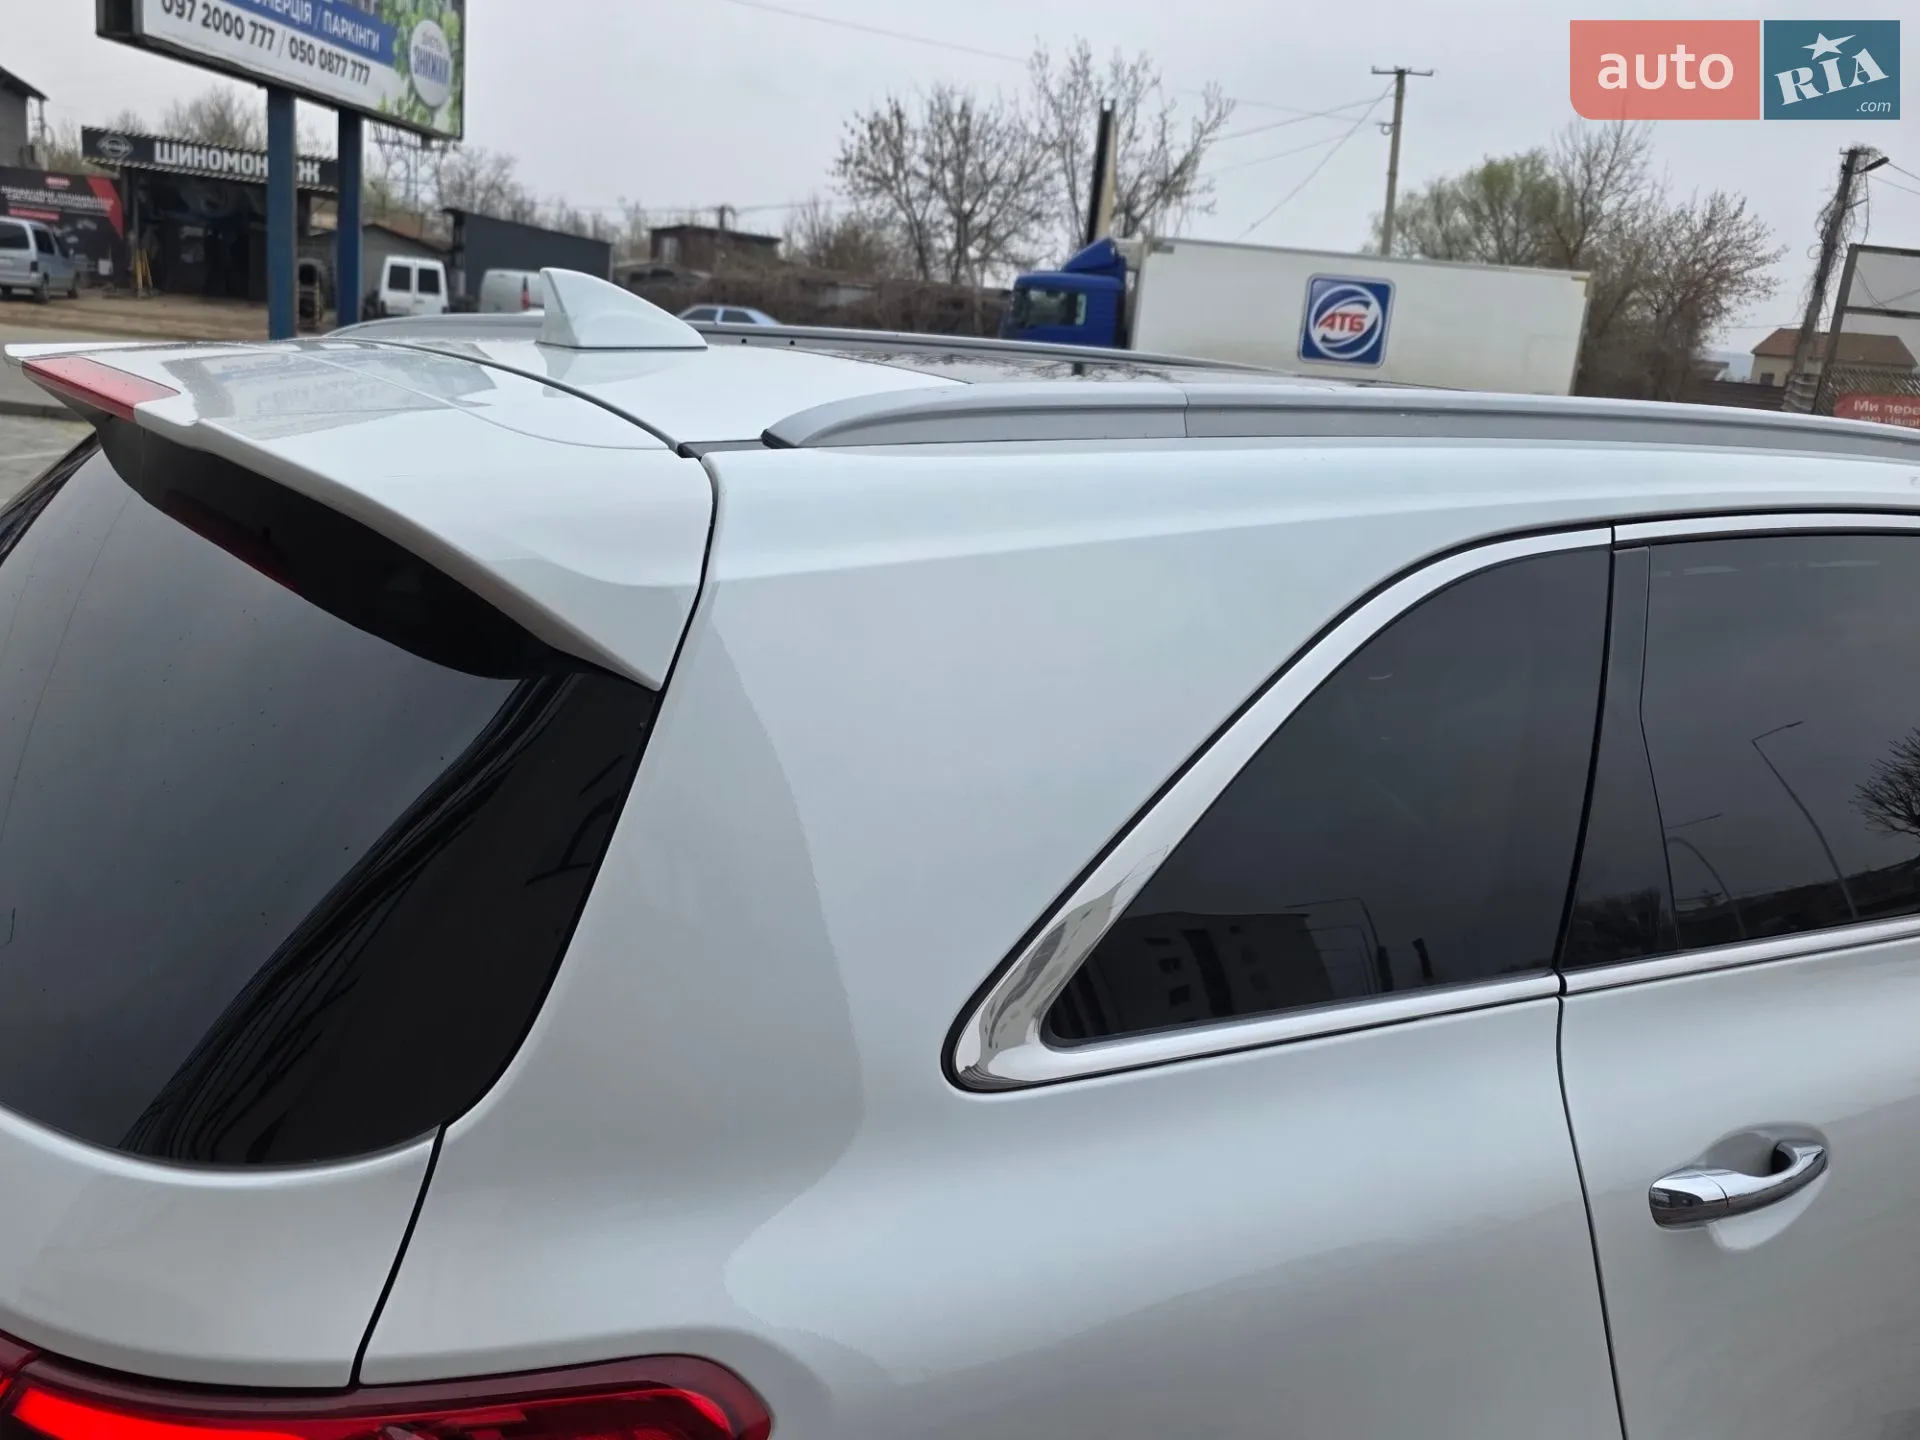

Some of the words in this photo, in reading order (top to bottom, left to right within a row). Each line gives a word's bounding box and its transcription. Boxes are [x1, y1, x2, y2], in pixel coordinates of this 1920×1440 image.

[162, 0, 196, 22] 097
[201, 4, 245, 40] 2000
[249, 20, 276, 50] 777
[289, 36, 316, 67] 050
[319, 47, 348, 76] 0877
[350, 59, 371, 85] 777
[252, 0, 312, 25] ЕРЦІЯ
[322, 9, 380, 53] ПАРКІНГИ
[154, 141, 320, 184] ШИНОМОНЖ
[1319, 312, 1368, 332] АТБ
[1854, 400, 1879, 413] Ми
